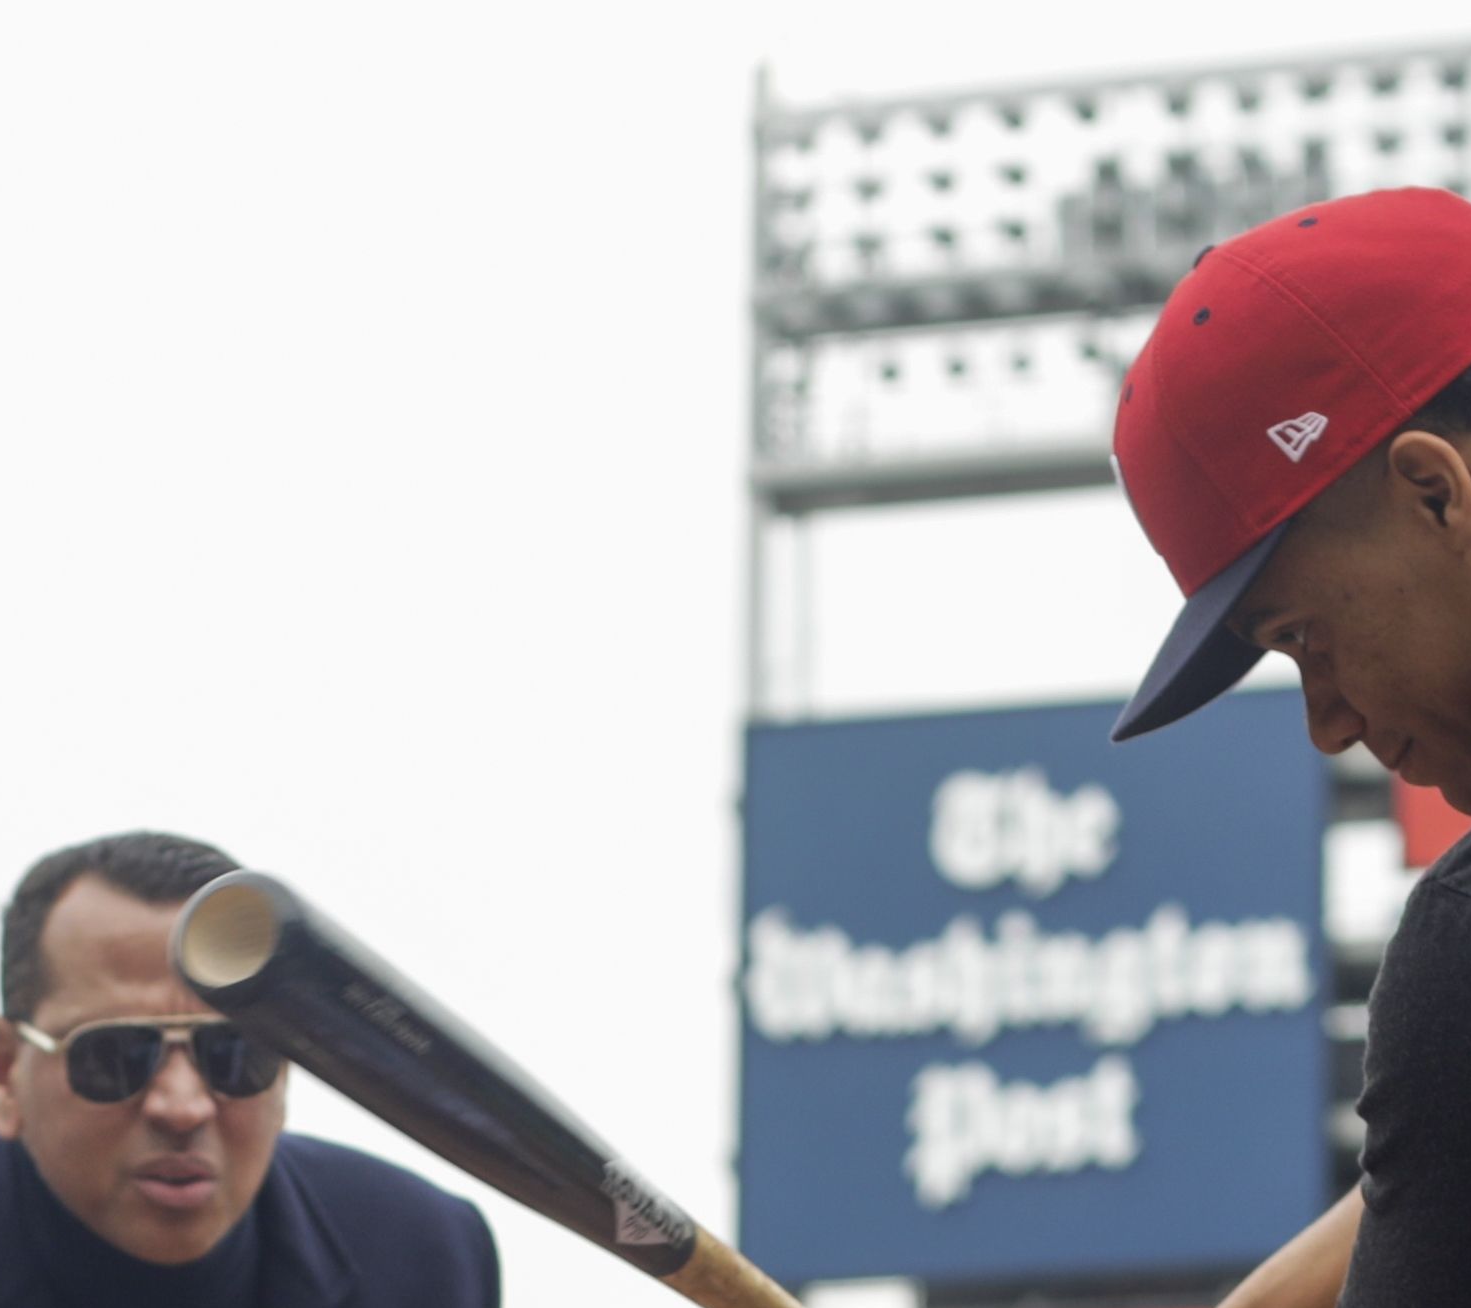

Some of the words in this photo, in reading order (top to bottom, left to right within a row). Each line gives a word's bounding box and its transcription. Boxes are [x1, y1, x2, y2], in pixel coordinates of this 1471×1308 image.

[930, 768, 1120, 897] The
[748, 904, 1313, 1043] Washington
[908, 1054, 1138, 1208] Post
